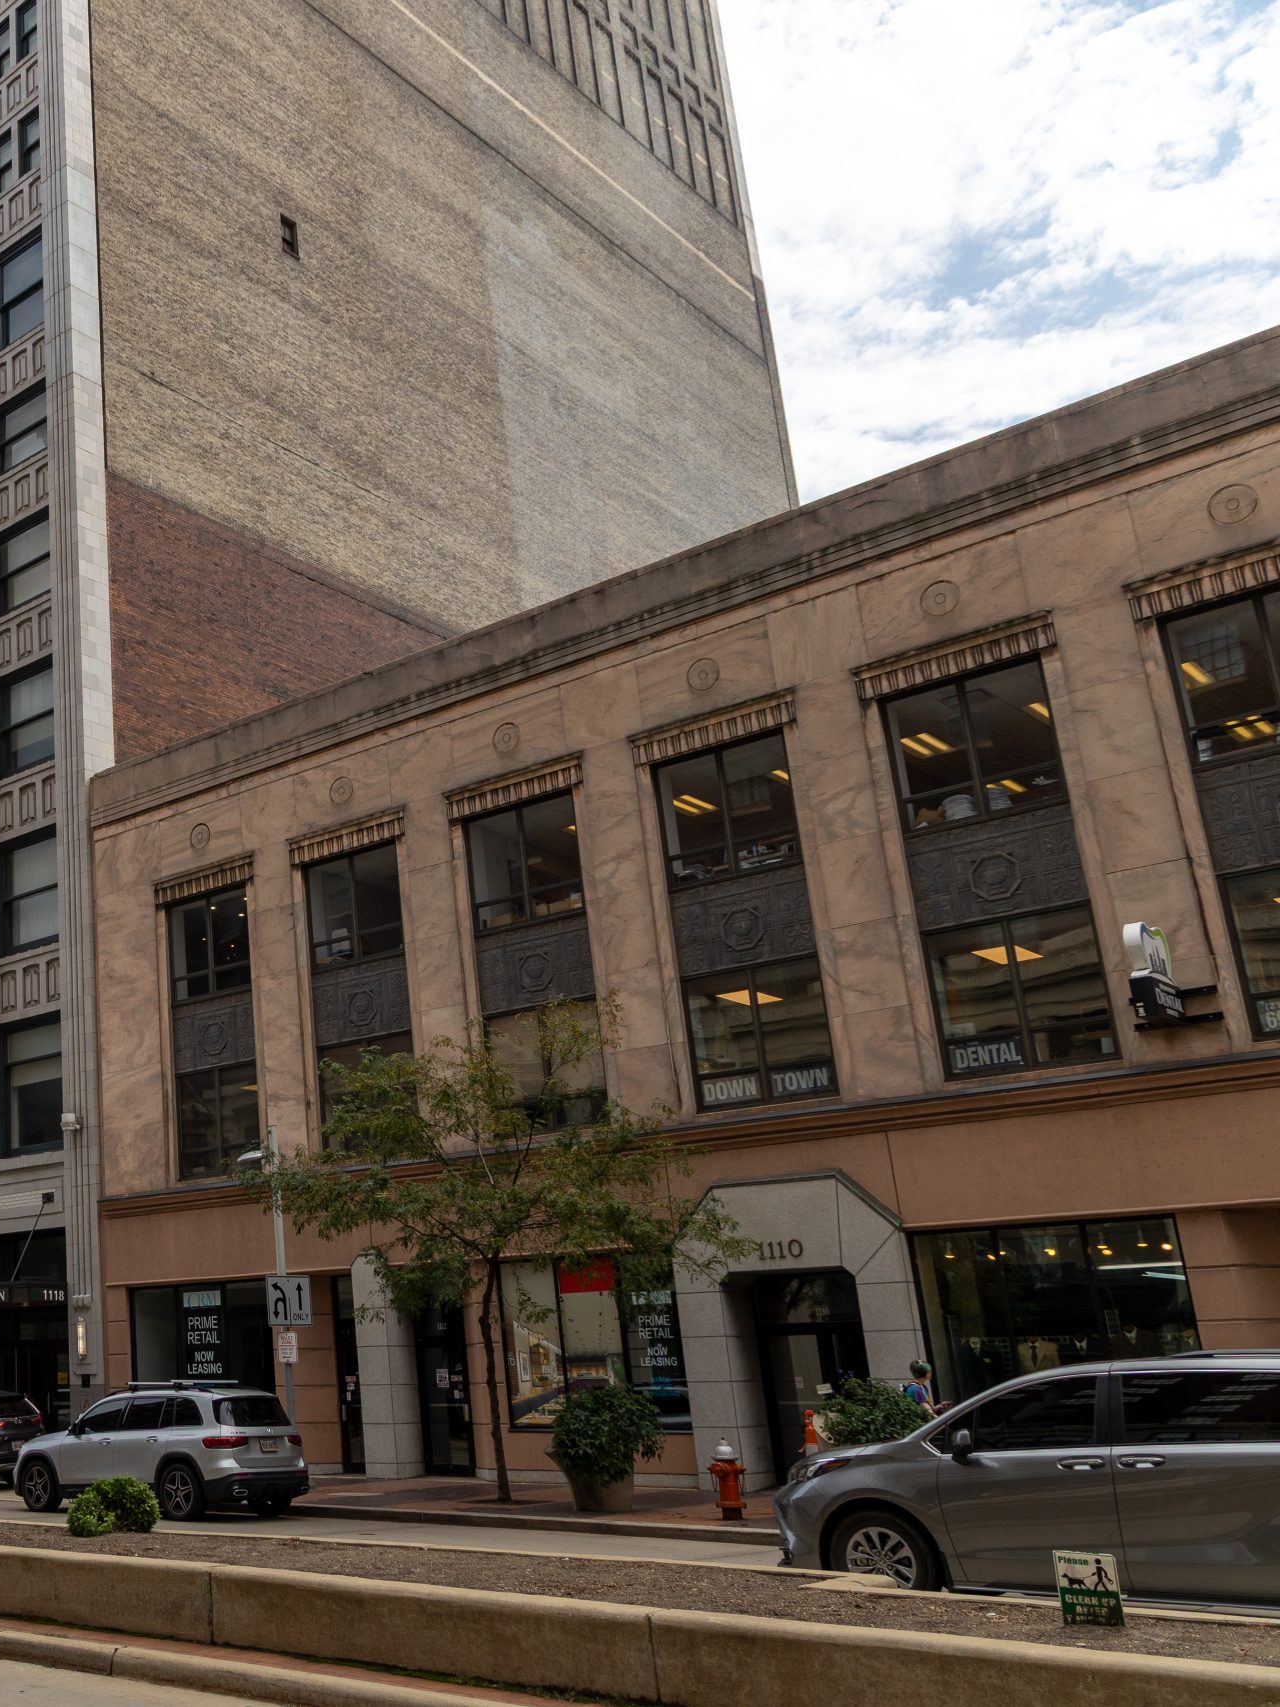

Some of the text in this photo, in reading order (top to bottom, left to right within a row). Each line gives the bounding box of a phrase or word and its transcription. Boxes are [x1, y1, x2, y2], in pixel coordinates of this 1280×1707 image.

[1154, 987, 1185, 1013] DENTAL
[955, 1041, 1022, 1069] DENTAL
[703, 1067, 829, 1102] DOWN TOWN
[759, 1238, 804, 1260] 1110
[42, 1289, 65, 1301] 1118
[188, 1315, 219, 1330] PRIME
[292, 1312, 310, 1321] ONLY
[638, 1314, 671, 1327] PRIME
[187, 1330, 221, 1345] RETAIL
[638, 1327, 674, 1339] RETAIL
[194, 1350, 214, 1362] NOW
[647, 1346, 668, 1357] NOW
[187, 1362, 223, 1375] LEASING
[640, 1357, 678, 1367] LEASING
[1057, 1555, 1089, 1566] Please
[1065, 1594, 1117, 1607] CLEAN UP
